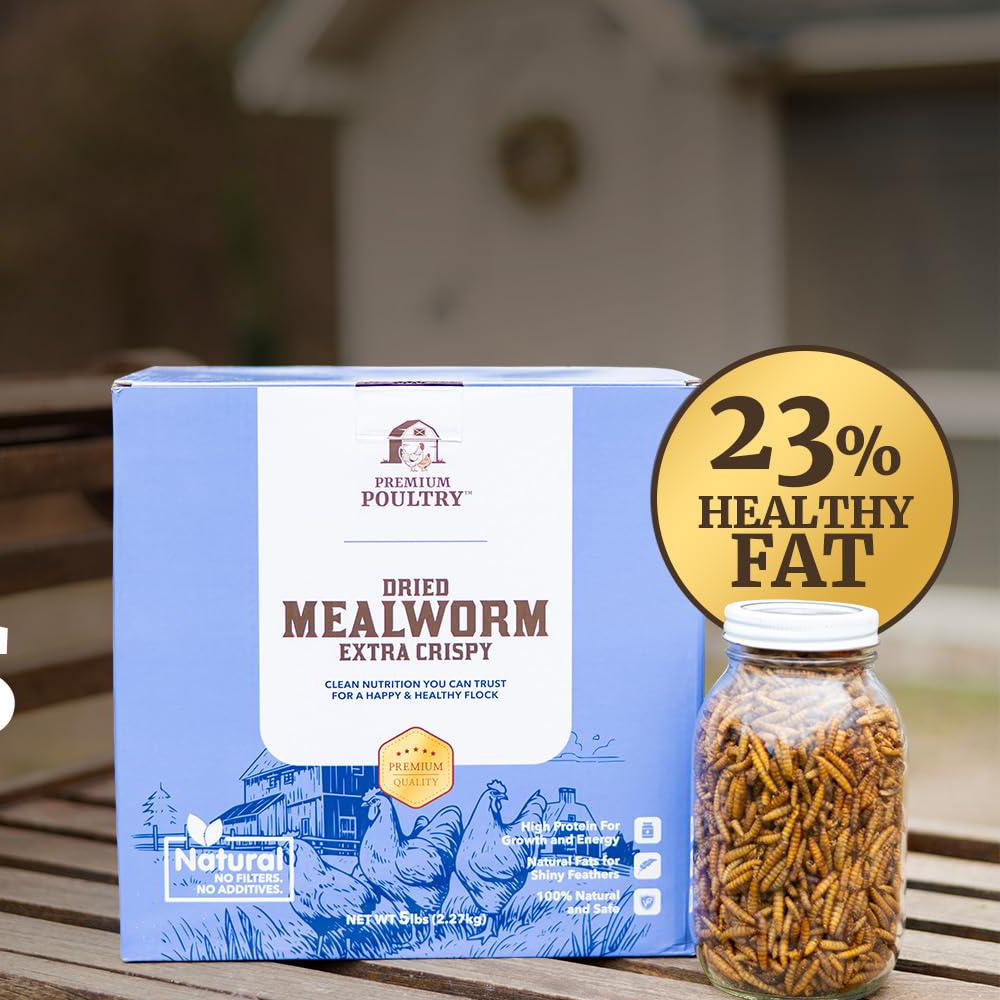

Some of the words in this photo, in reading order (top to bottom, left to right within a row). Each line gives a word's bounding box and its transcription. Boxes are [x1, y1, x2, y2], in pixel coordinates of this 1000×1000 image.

[374, 477, 452, 489] PREMIUM
[382, 578, 450, 598] DRIED
[282, 599, 549, 639] MEALWORM
[339, 642, 410, 662] EXTRA
[415, 642, 493, 662] CRISPY
[324, 679, 359, 689] CLEAN
[362, 679, 421, 689] NUTRITION
[423, 679, 447, 689] YOU
[448, 679, 473, 689] CAN
[474, 679, 507, 689] TRUST
[331, 691, 354, 700] FOR
[355, 691, 364, 700] A
[366, 691, 402, 700] HAPPY
[403, 691, 412, 700] &
[414, 691, 462, 700] HEALTHY
[464, 691, 499, 700] FLOCK
[388, 761, 443, 772] PREMIUM
[393, 777, 439, 788] QUALITY
[521, 821, 550, 834] High
[553, 821, 598, 831] Protein
[600, 821, 621, 831] For
[502, 834, 547, 846] Growth
[550, 834, 574, 845] and
[576, 835, 620, 847] Energy
[175, 846, 284, 872] Natural
[527, 856, 572, 867] Natural
[575, 856, 600, 867] Fats
[602, 855, 620, 866] for
[214, 873, 234, 884] NO
[236, 873, 284, 884] FILTERS.
[531, 869, 565, 883] Shiny
[568, 869, 620, 880] Feathers
[196, 884, 216, 895] NO
[217, 884, 284, 895] ADDITIVES.
[536, 891, 573, 902] 100%
[575, 890, 621, 901] Natural
[567, 903, 591, 914] and
[592, 903, 620, 914] Safe
[345, 914, 372, 925] NET
[374, 913, 396, 925] WT
[398, 910, 429, 926] 5lbs
[431, 913, 487, 927] (2.27kg)
